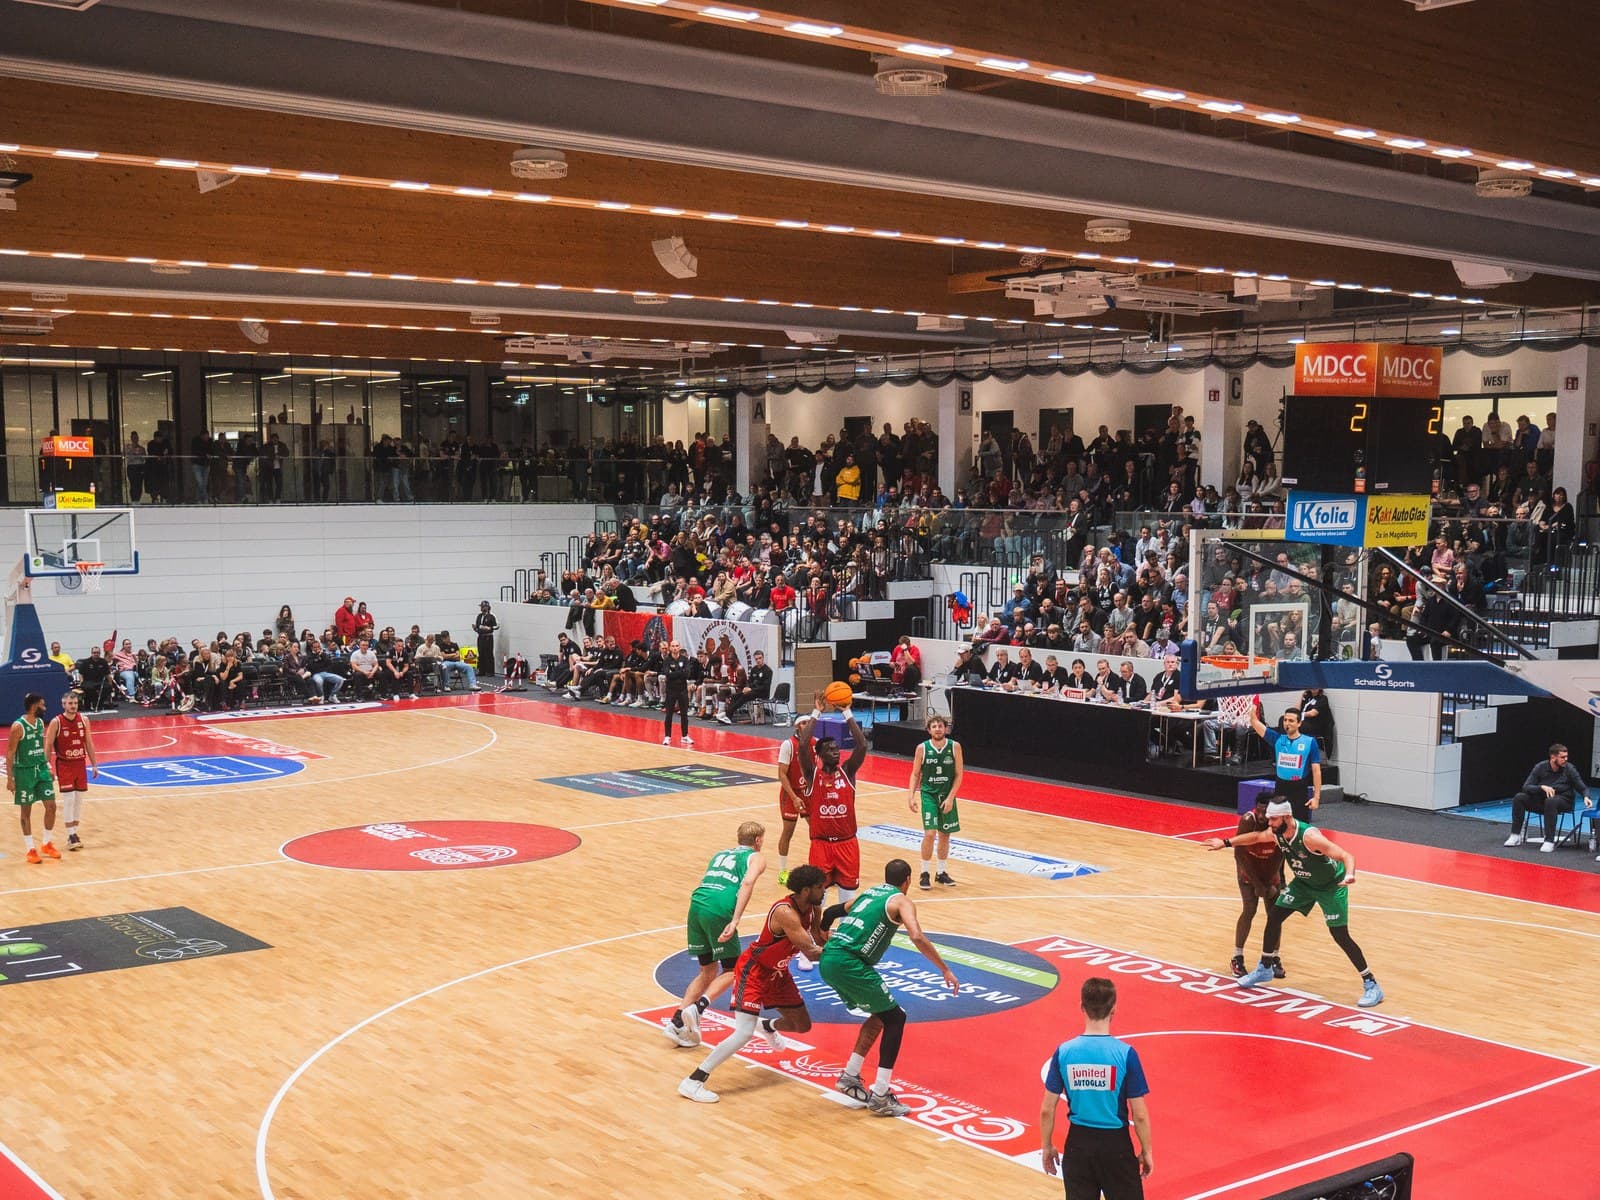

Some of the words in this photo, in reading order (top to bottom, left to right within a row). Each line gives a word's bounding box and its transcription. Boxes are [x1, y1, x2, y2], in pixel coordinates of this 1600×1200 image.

[1303, 354, 1367, 377] MDCC
[1383, 356, 1434, 380] MDCC
[1231, 379, 1241, 400] C
[1482, 375, 1509, 387] WEST
[753, 400, 766, 420] A
[960, 391, 971, 411] B
[1350, 403, 1367, 432] 2
[1428, 407, 1441, 435] 2
[58, 440, 89, 450] MDCC
[65, 458, 73, 471] 7
[1375, 531, 1383, 539] 2x
[1383, 531, 1389, 539] in
[1389, 531, 1418, 540] Magdeburg
[1387, 679, 1415, 688] Sports
[834, 779, 846, 789] 34
[1291, 859, 1304, 869] 22
[860, 921, 886, 954] EINSTEIN
[905, 967, 988, 994] SPORT
[1034, 938, 1333, 1020] WERSOMA
[973, 990, 1021, 1005] IN
[1072, 1067, 1106, 1079] junited
[1073, 1079, 1106, 1087] AUTOGLAS
[933, 1091, 992, 1115] KREATIVE
